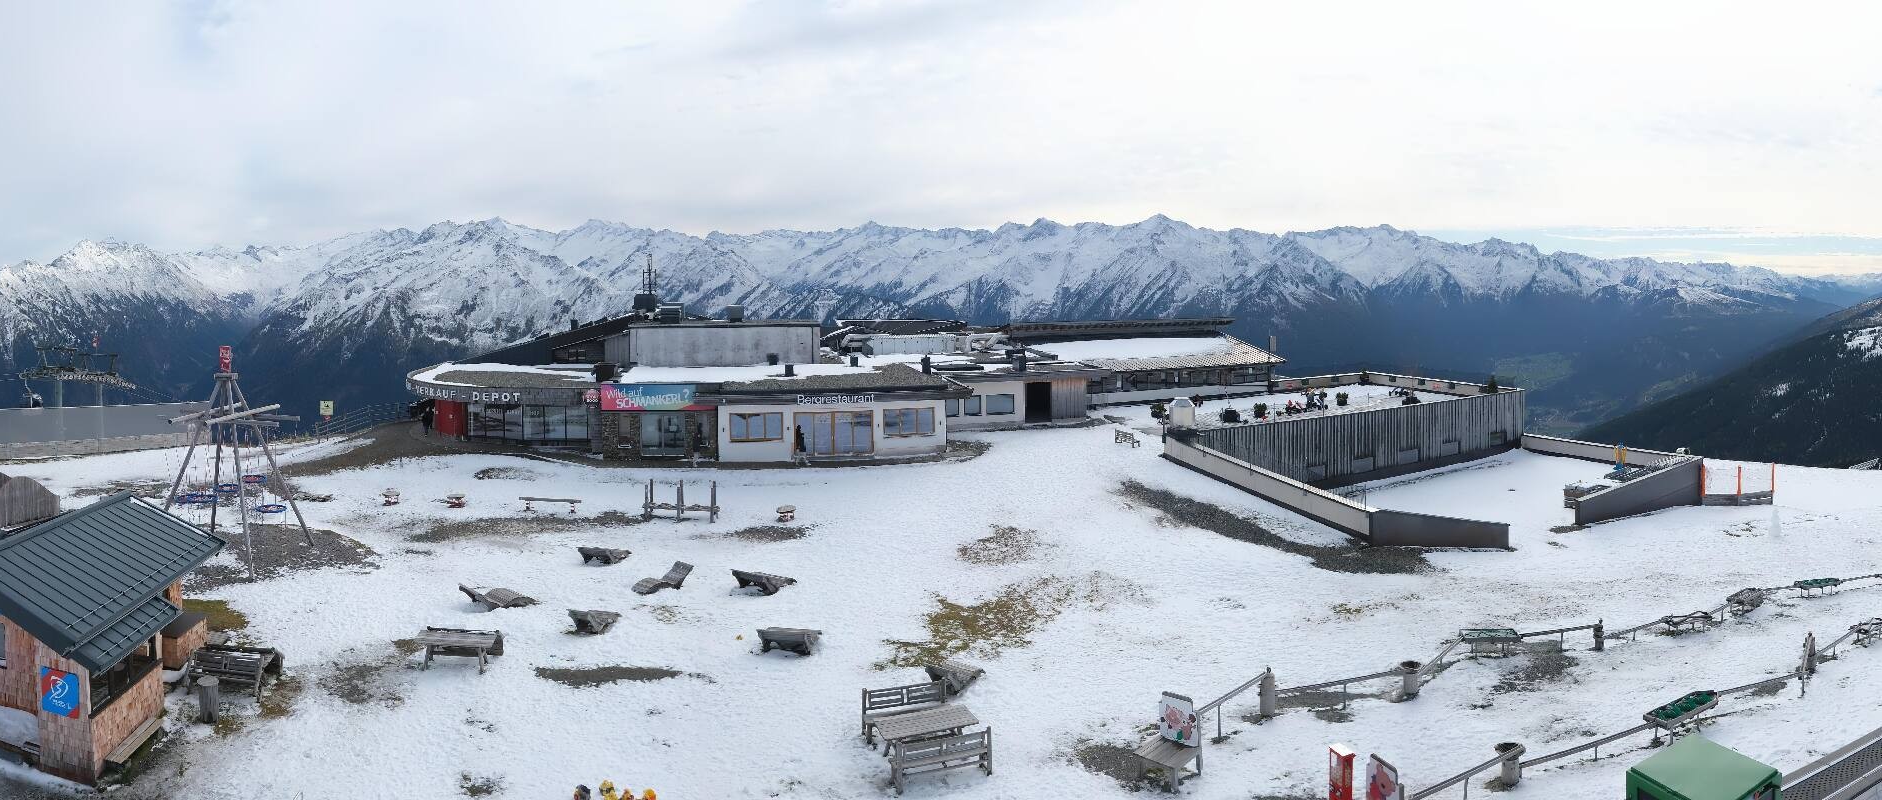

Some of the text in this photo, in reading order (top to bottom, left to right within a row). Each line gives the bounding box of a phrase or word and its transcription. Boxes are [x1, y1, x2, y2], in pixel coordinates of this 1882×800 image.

[472, 391, 521, 402] DEPOT
[606, 388, 626, 399] Wild
[628, 386, 644, 398] auf
[797, 394, 874, 405] Bergrestaurant
